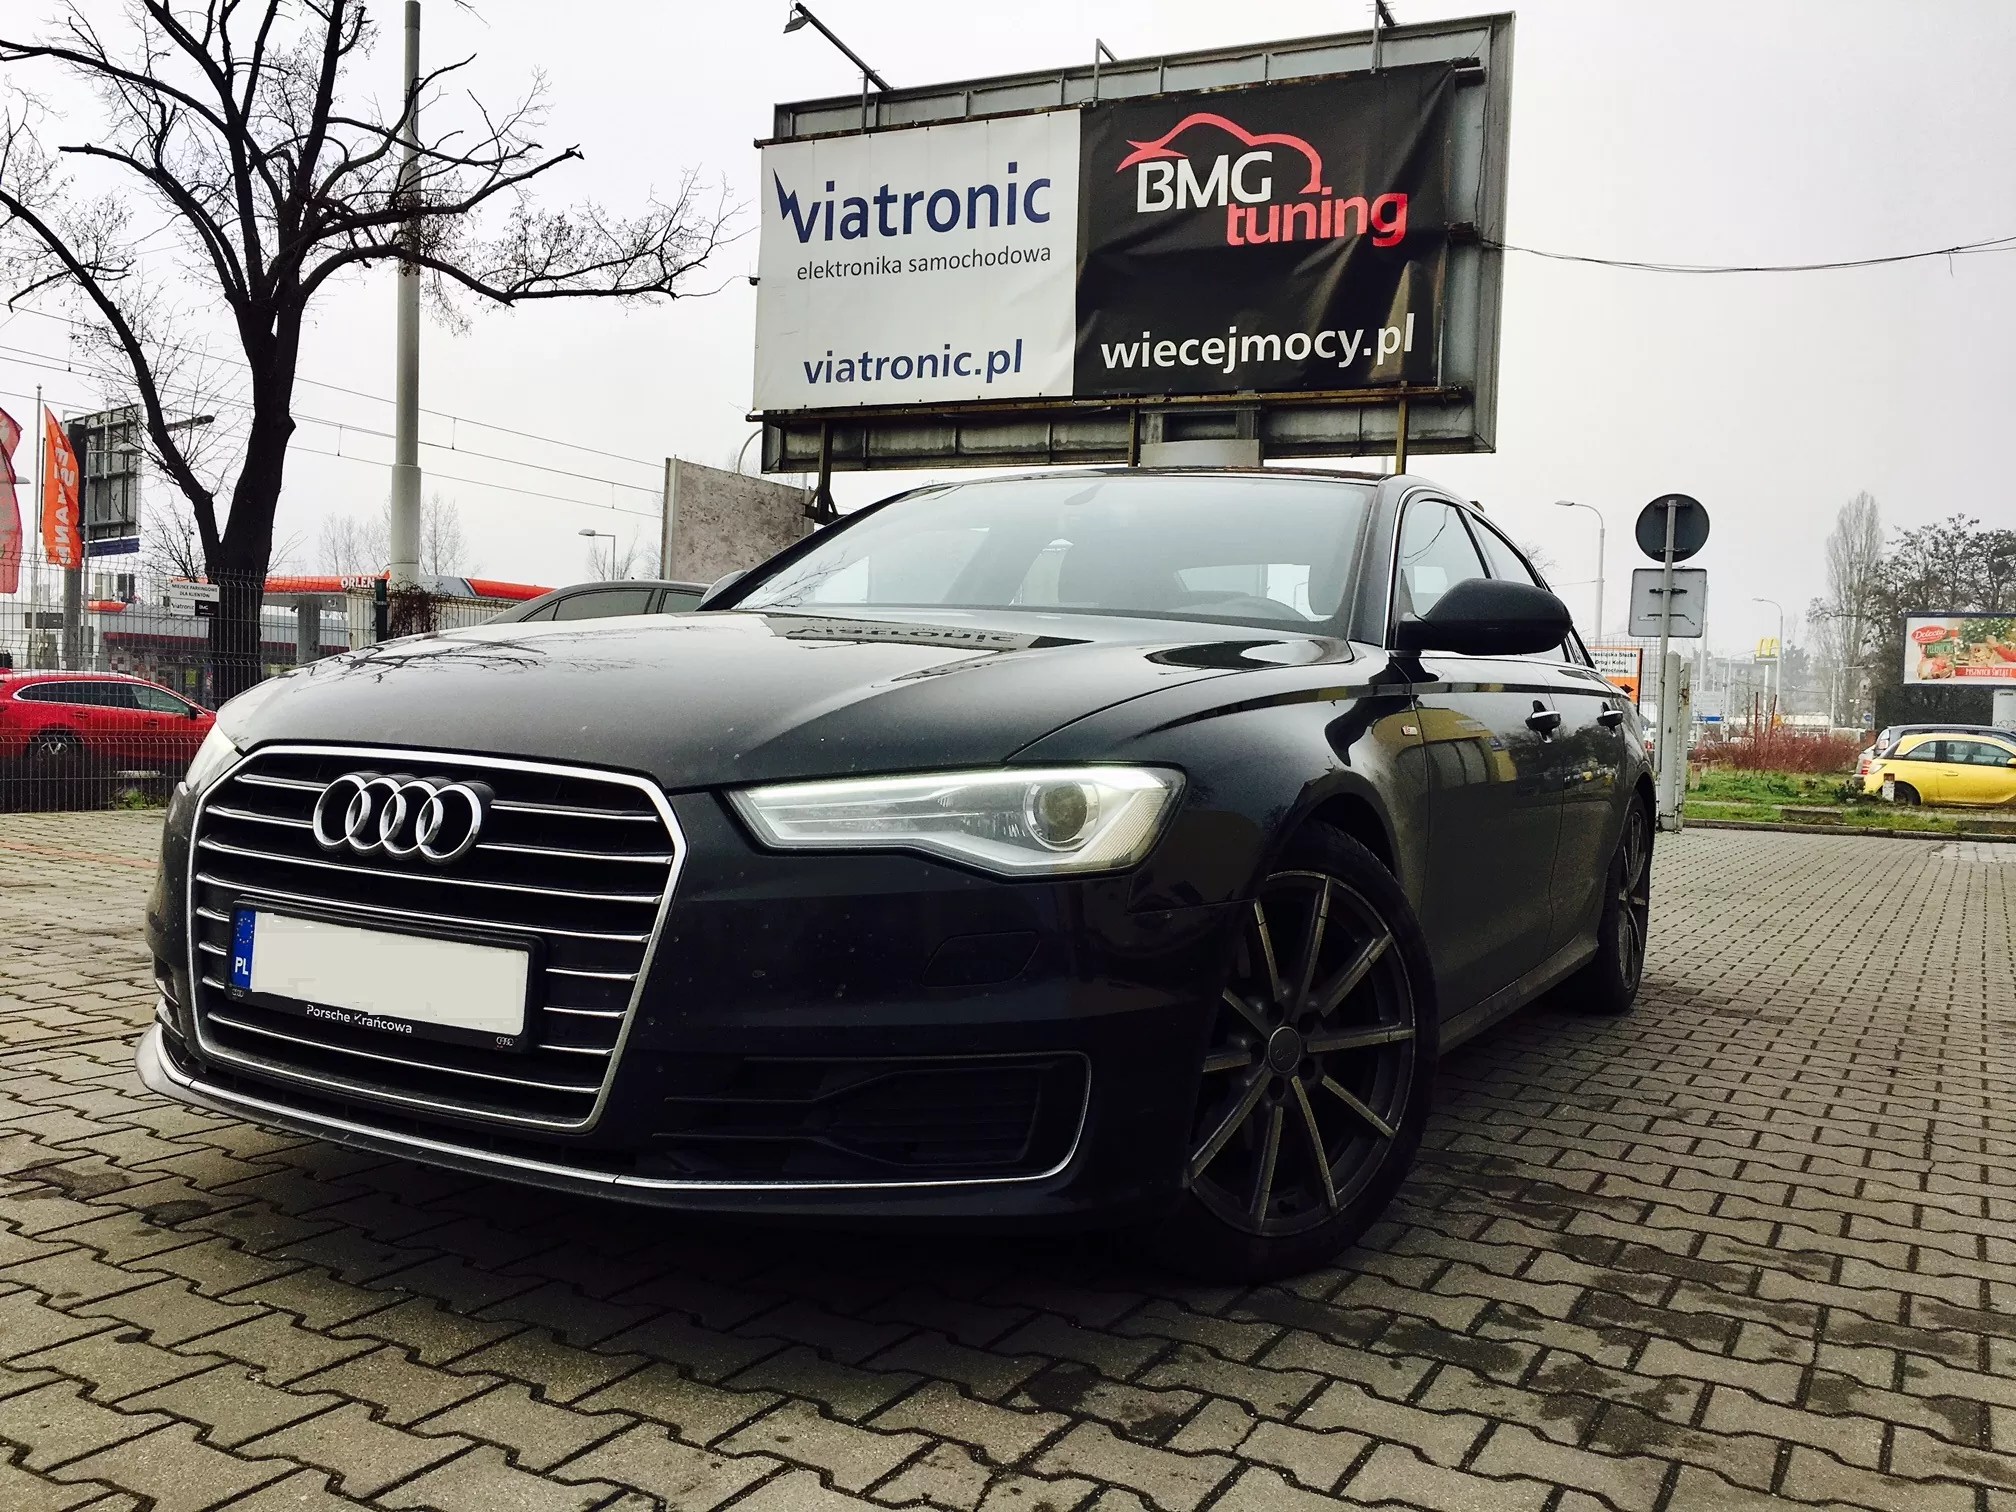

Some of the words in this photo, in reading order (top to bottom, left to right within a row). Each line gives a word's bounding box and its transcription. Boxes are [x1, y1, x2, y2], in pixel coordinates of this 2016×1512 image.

[773, 161, 1051, 244] viatronic
[1136, 150, 1273, 213] BMG
[1226, 186, 1408, 247] tuning
[797, 255, 902, 281] elektronika
[908, 245, 1051, 275] samochodowa
[803, 338, 1023, 385] viatronic.pl
[1101, 312, 1415, 374] wiecejmocy.pl
[340, 576, 375, 588] ORLEN
[234, 956, 250, 976] PL
[306, 1004, 351, 1023] Porsche
